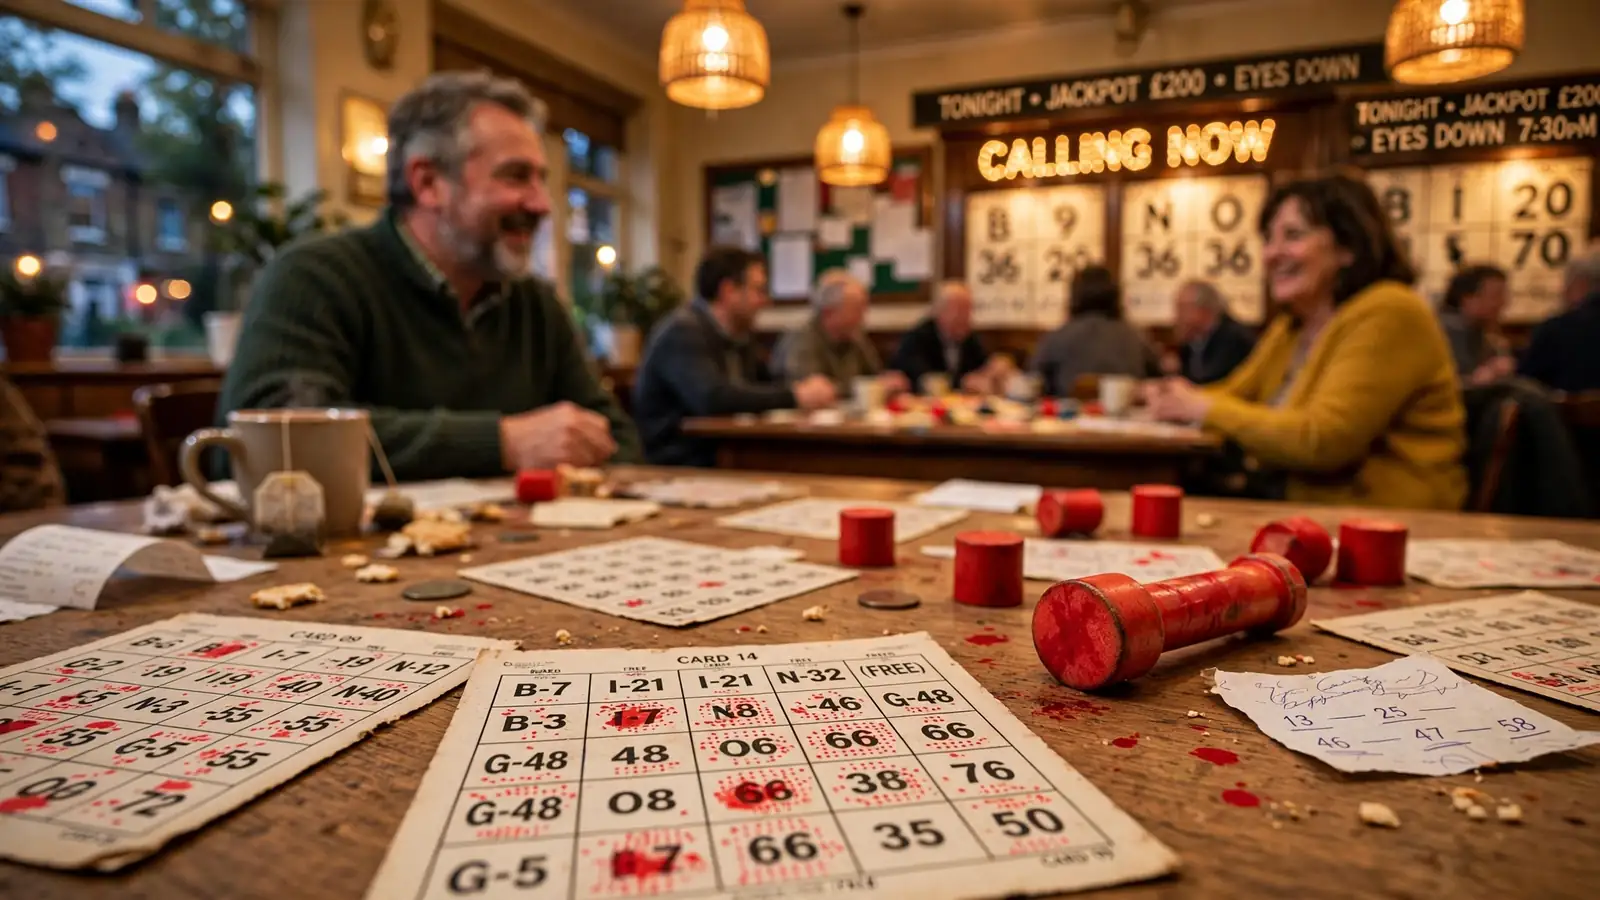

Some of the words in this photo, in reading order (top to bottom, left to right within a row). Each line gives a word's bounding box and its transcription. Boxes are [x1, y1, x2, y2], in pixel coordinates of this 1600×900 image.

[938, 88, 1024, 120] TONIGHT
[1045, 75, 1141, 111] JACKPOT
[1149, 68, 1206, 99] £200
[1234, 63, 1290, 91] EYES
[1295, 56, 1360, 82] DOWN
[1356, 96, 1442, 125] TONIGHT
[1460, 88, 1550, 117] JACKPOT
[978, 128, 1152, 182] CALLING
[1167, 118, 1276, 168] NOW
[1372, 126, 1428, 153] EYES
[1434, 120, 1505, 150] DOWN
[1513, 181, 1574, 220] 20
[1511, 229, 1572, 270] 70
[385, 660, 451, 676] N-12
[677, 655, 729, 664] CARD
[738, 652, 759, 661] 14
[513, 681, 572, 697] B-7
[609, 678, 665, 693] I-21
[698, 673, 753, 689] I-21
[776, 668, 846, 684] N-32
[860, 661, 926, 679] (FREE)
[123, 696, 190, 714] N-3
[502, 713, 567, 732] B-3
[883, 689, 955, 707] G-48
[1283, 714, 1314, 728] 13
[1373, 706, 1408, 719] 25
[43, 728, 110, 747] 55
[115, 738, 190, 758] G-5
[484, 750, 569, 775] G-48
[611, 744, 670, 765] 48
[825, 729, 879, 749] 66
[921, 722, 976, 741] 66
[1317, 736, 1351, 749] 46
[1415, 726, 1445, 741] 47
[1497, 716, 1537, 733] 58
[466, 796, 563, 827] G-48
[845, 769, 909, 794] 38
[950, 760, 1016, 784] 76
[449, 856, 549, 895] G-5
[747, 832, 818, 865] 66
[873, 819, 946, 851] 35
[991, 807, 1065, 838] 50
